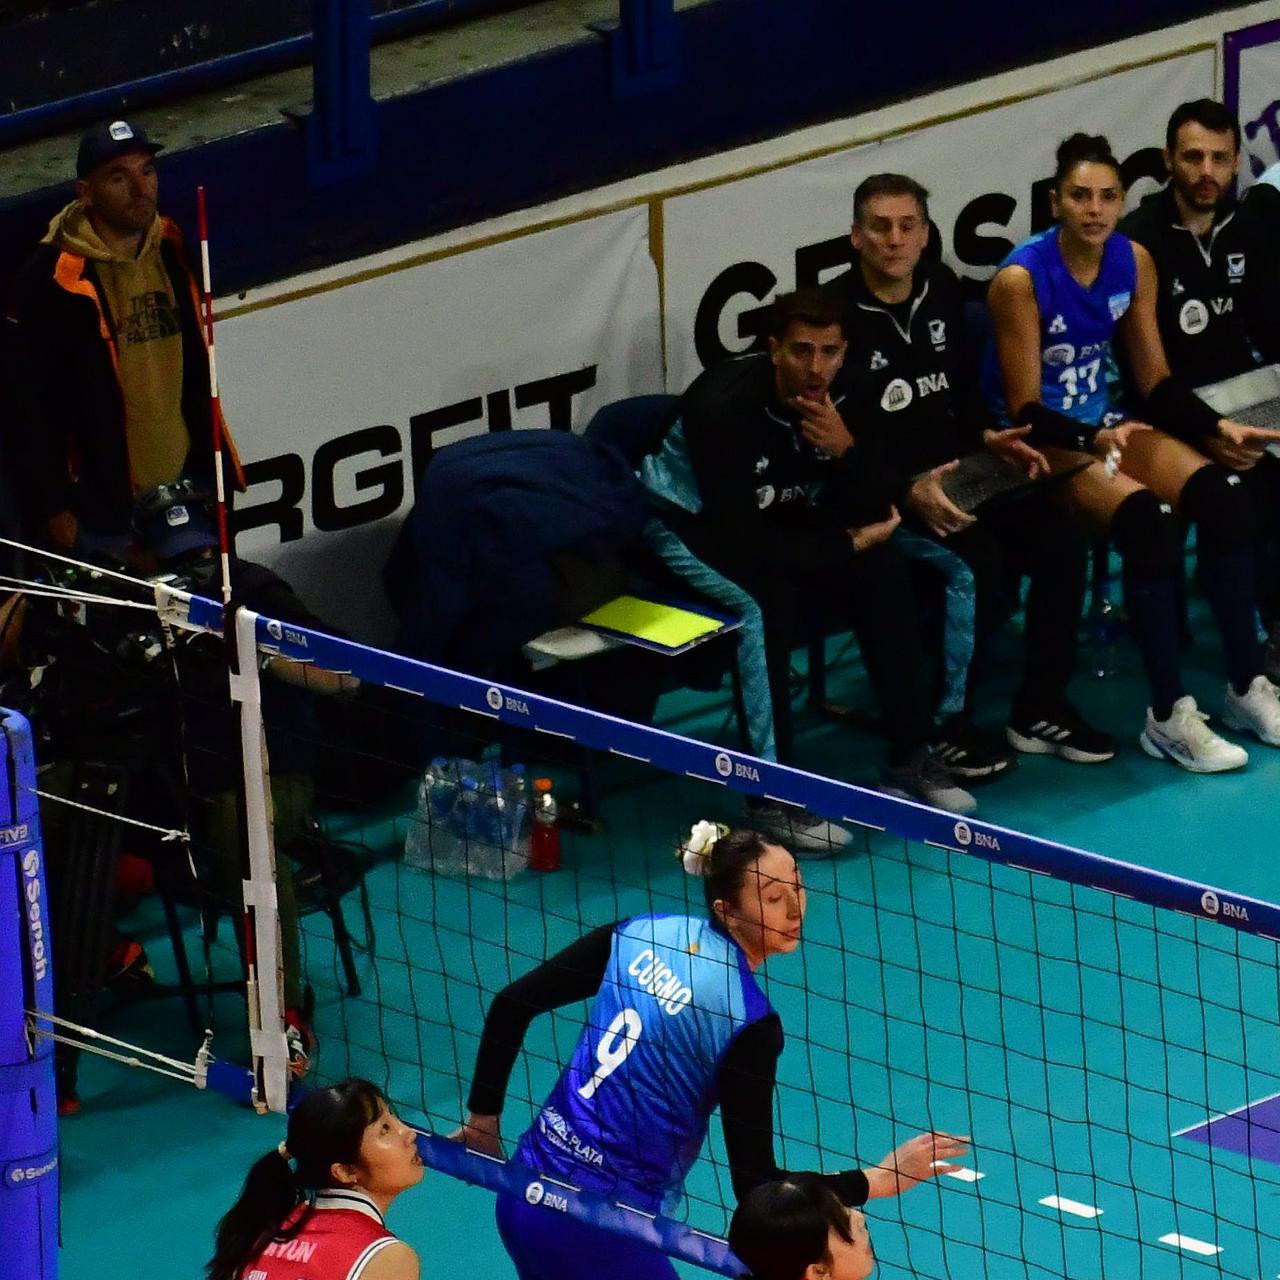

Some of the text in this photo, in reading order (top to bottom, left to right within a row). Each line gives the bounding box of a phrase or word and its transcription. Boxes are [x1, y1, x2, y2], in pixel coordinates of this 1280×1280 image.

[1058, 360, 1102, 410] 17
[506, 697, 529, 714] BNA
[736, 764, 759, 781] BNA
[975, 832, 1000, 850] BNA
[1223, 902, 1248, 920] BNA
[628, 948, 692, 1015] CUGNO
[578, 1008, 642, 1099] 9
[544, 1193, 567, 1211] BNA
[263, 1239, 318, 1264] AYUN
